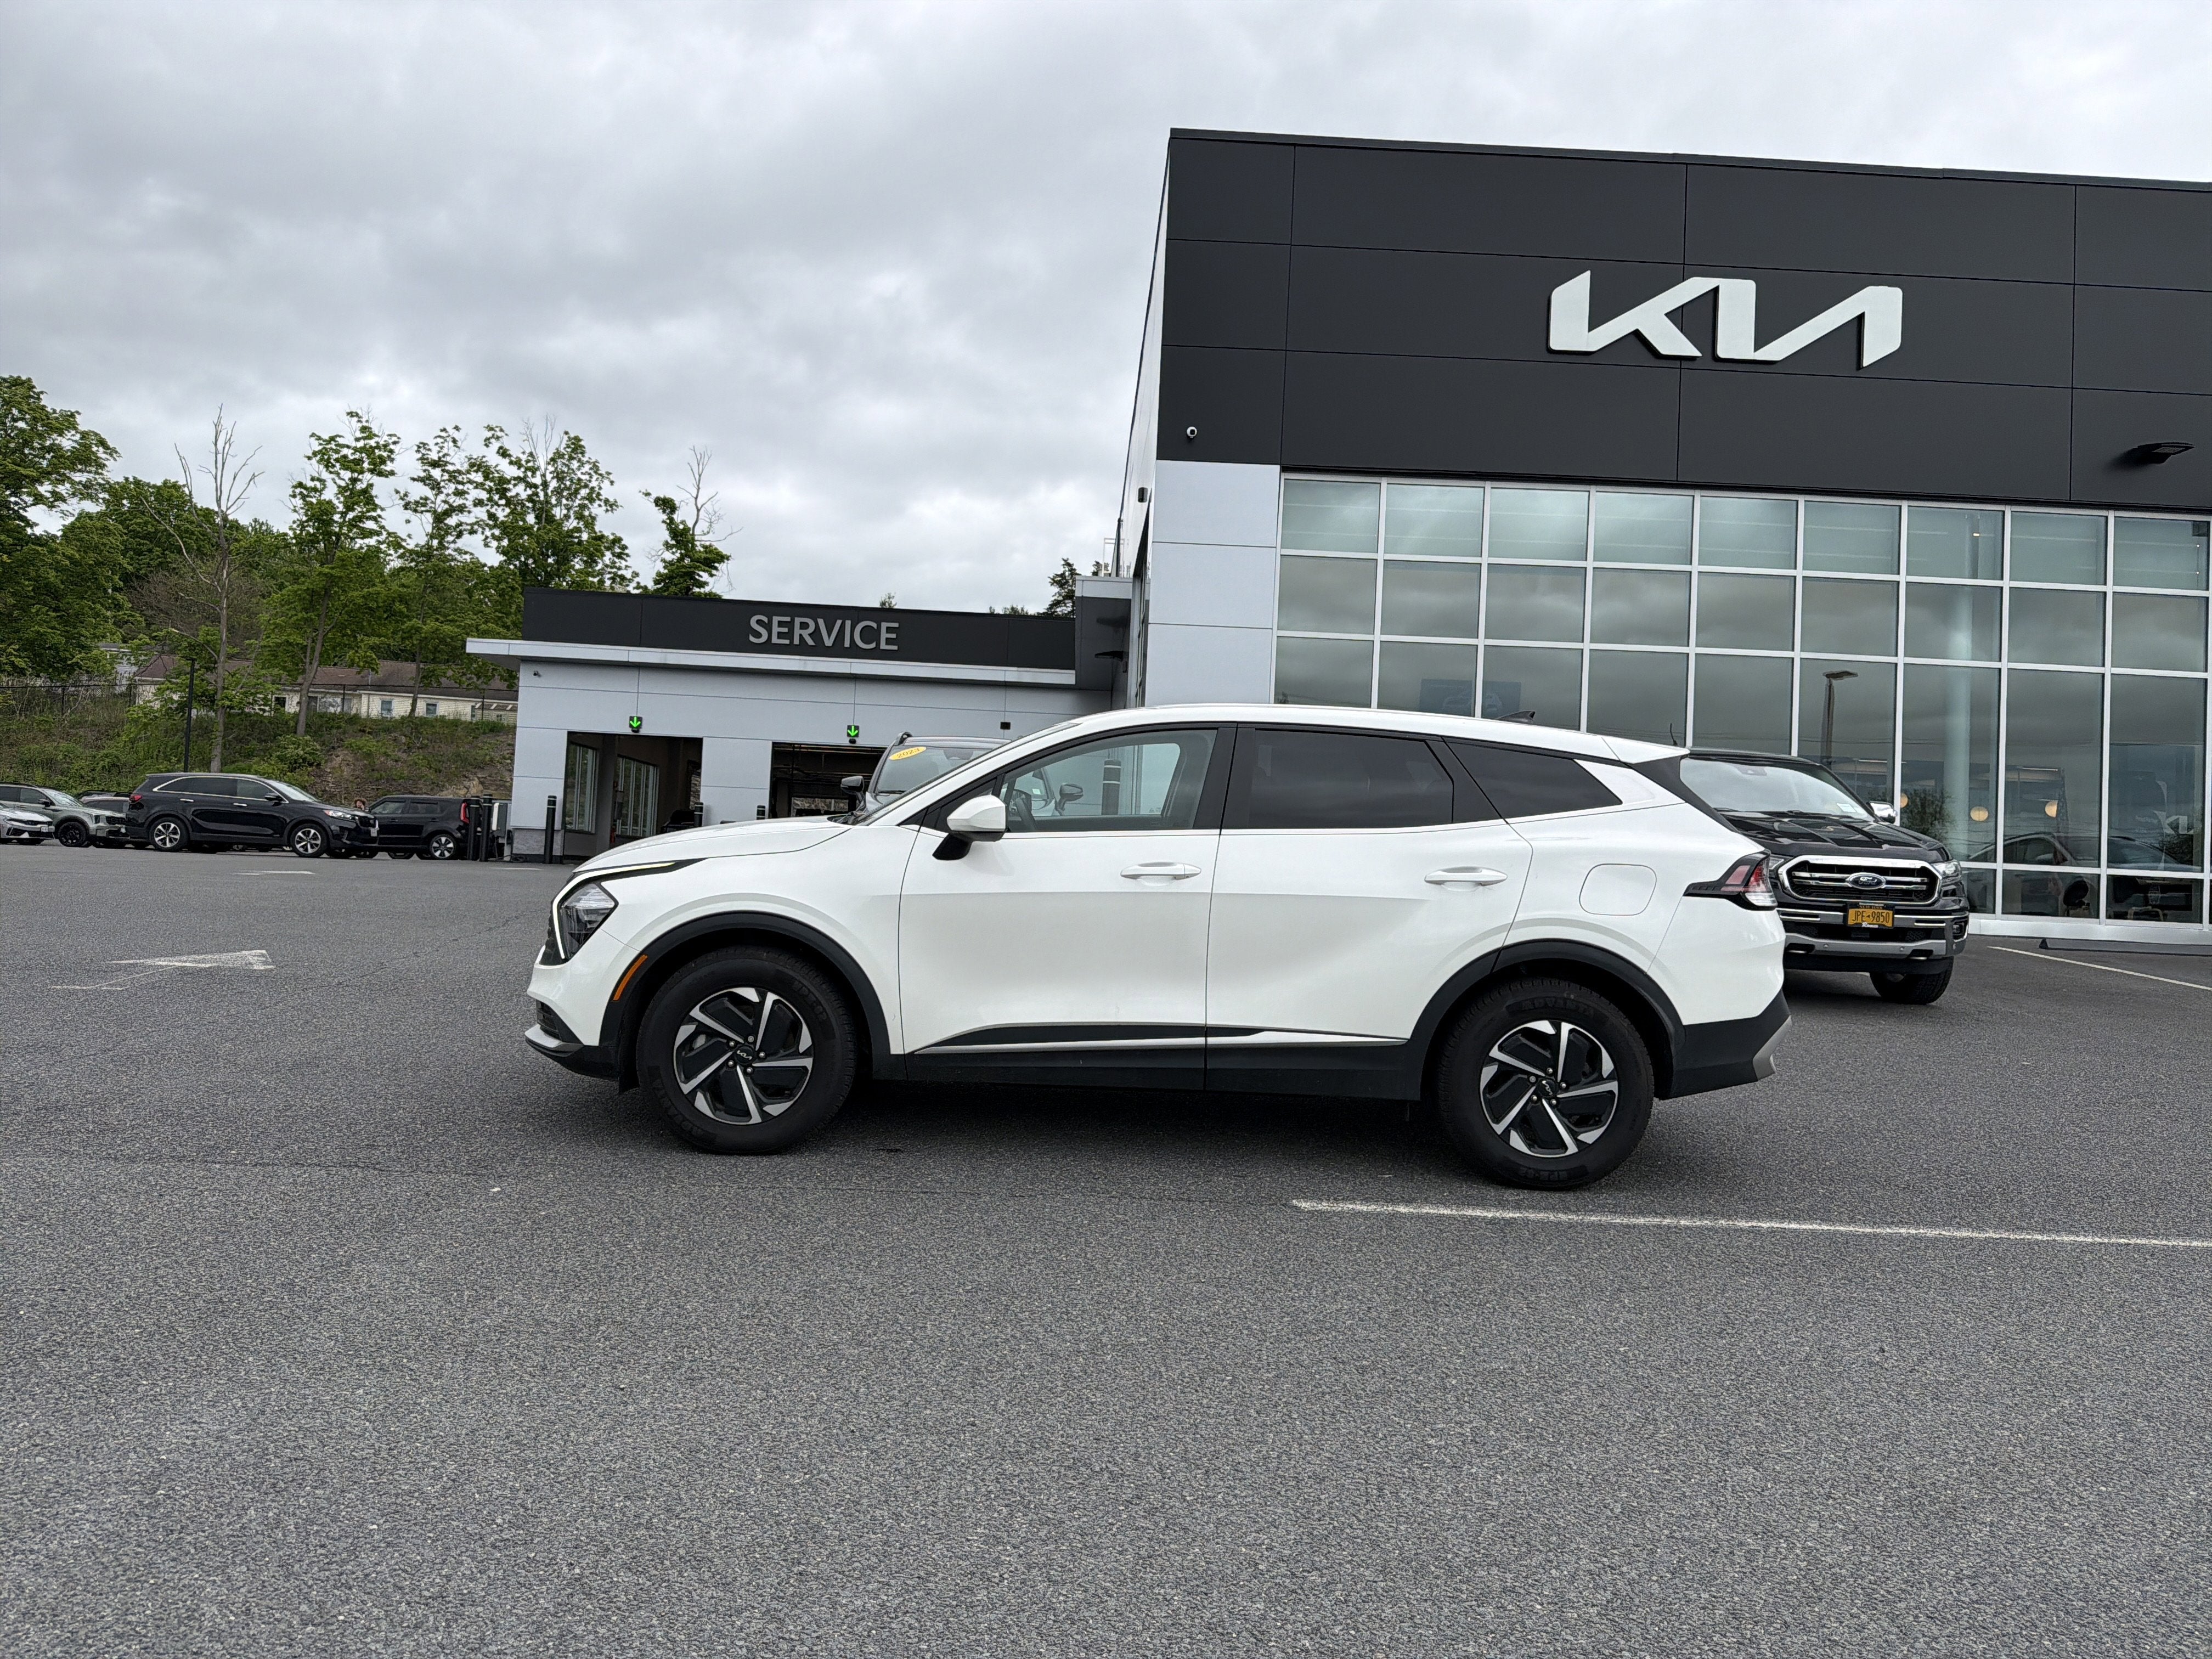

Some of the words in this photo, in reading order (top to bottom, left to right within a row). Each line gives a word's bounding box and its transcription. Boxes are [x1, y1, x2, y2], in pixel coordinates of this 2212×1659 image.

[1549, 270, 1903, 368] KIA
[749, 614, 899, 651] SERVICE
[1859, 876, 1877, 885] Ford
